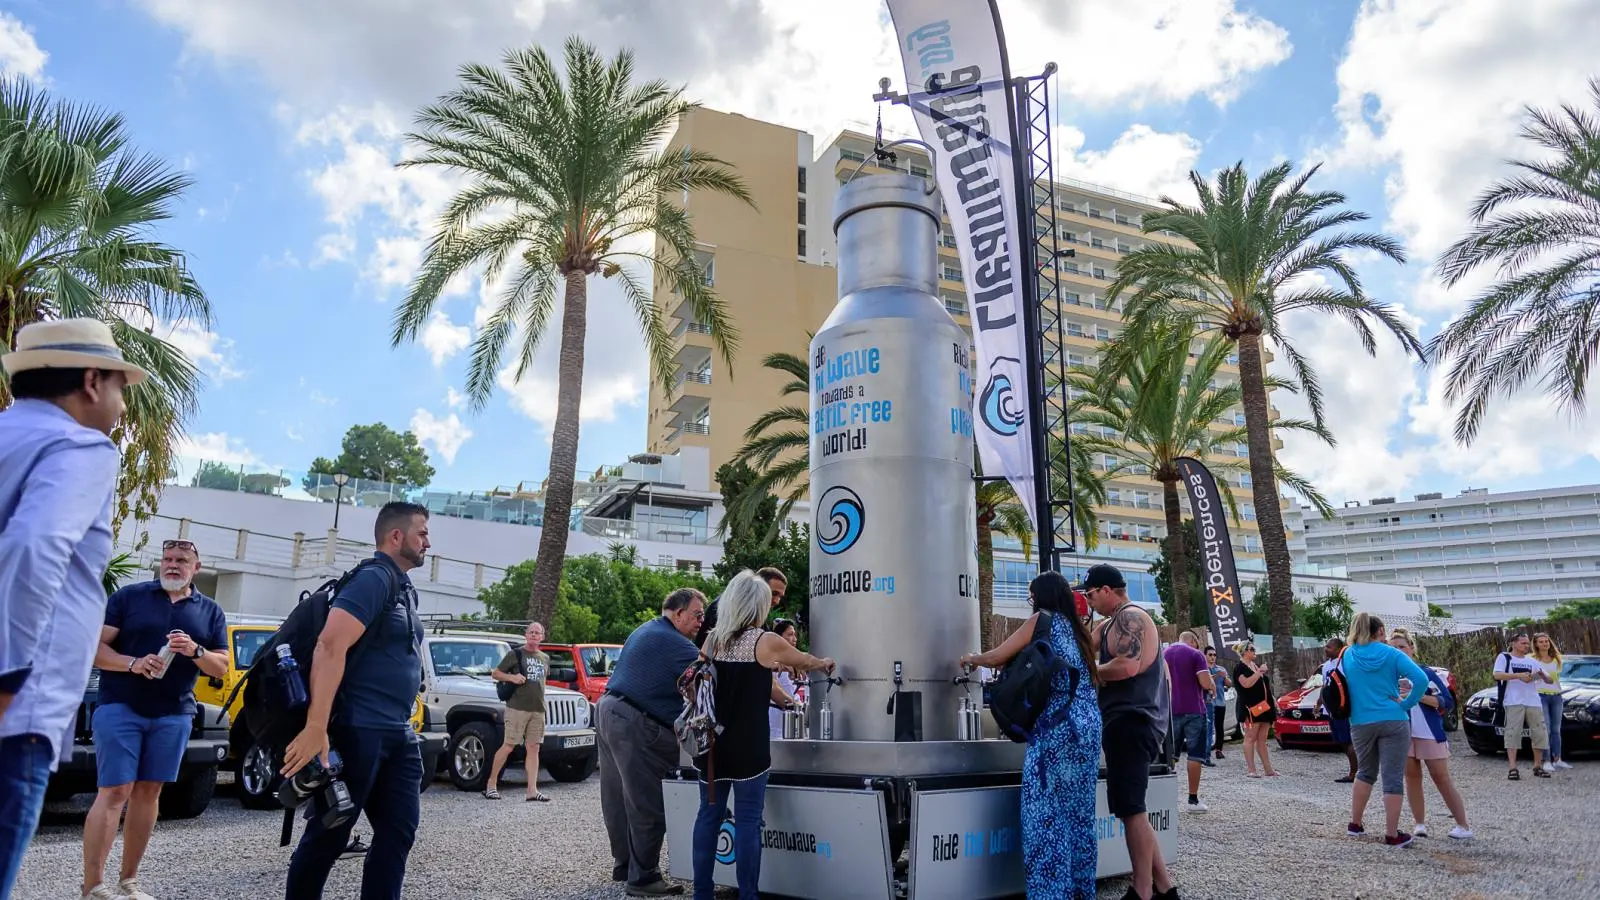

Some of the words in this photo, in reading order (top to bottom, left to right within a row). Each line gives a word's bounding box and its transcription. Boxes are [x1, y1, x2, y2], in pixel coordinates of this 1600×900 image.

[828, 347, 880, 384] wave
[858, 385, 865, 397] a
[851, 399, 892, 425] free
[823, 428, 867, 458] world!
[932, 833, 959, 862] Ride
